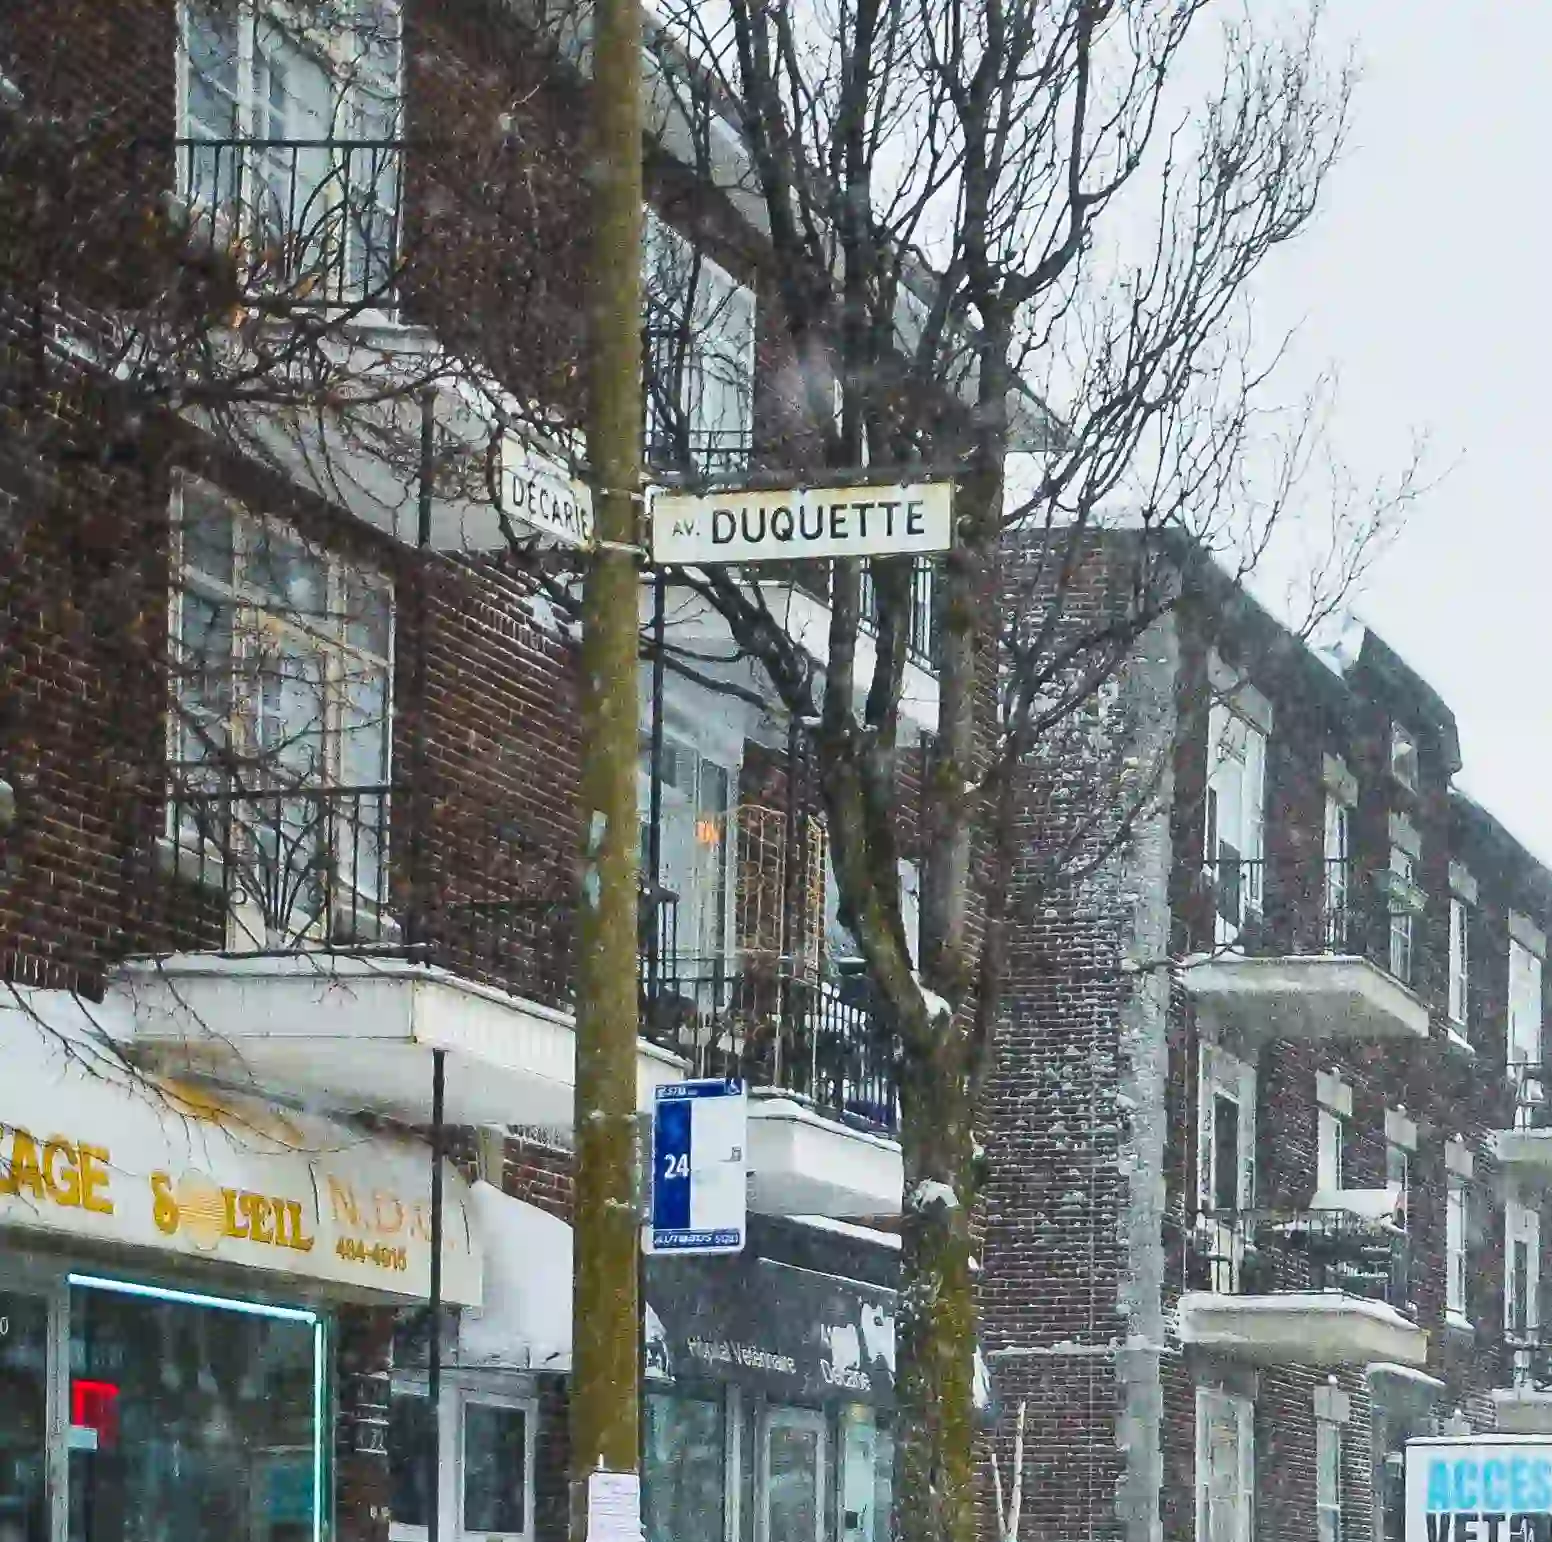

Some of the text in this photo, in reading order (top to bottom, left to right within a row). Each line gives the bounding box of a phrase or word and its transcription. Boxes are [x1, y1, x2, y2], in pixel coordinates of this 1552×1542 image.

[671, 499, 925, 545] AV. DUQUETTE
[0, 1124, 115, 1215] AGE
[664, 1153, 690, 1180] 24
